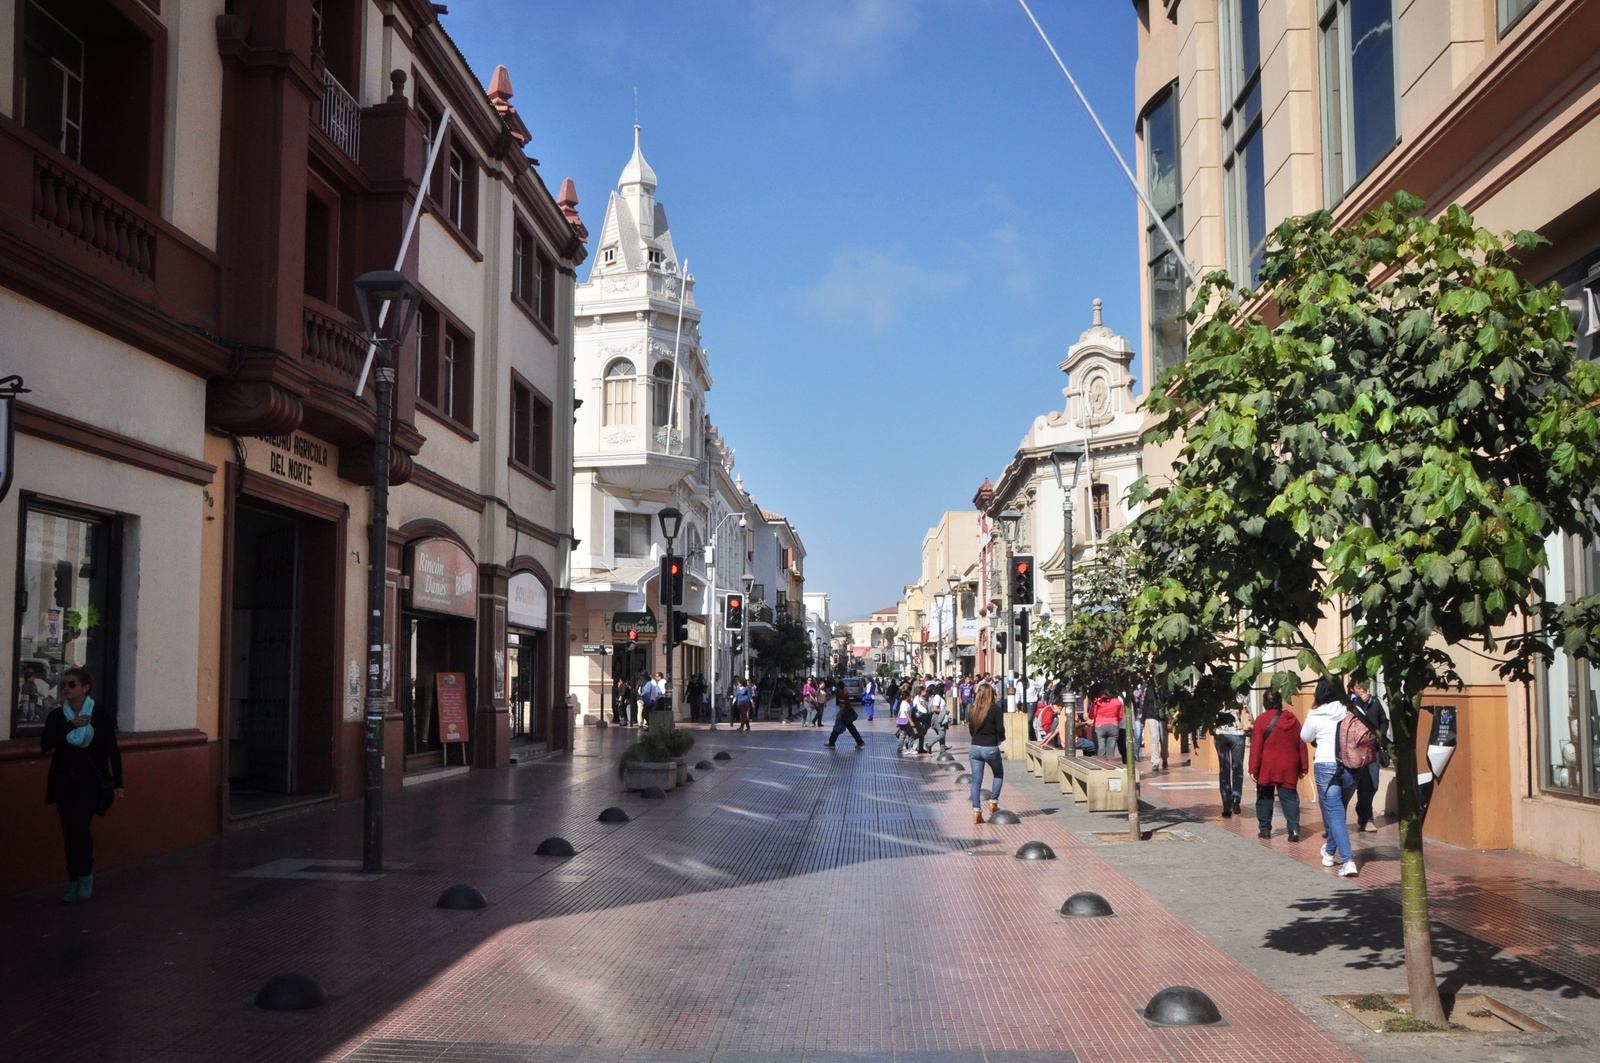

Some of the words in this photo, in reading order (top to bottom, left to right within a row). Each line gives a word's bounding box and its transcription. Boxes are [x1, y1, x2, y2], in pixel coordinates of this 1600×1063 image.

[294, 435, 328, 466] AGRICOLA
[270, 451, 286, 476] DEL
[288, 458, 313, 486] NORTE
